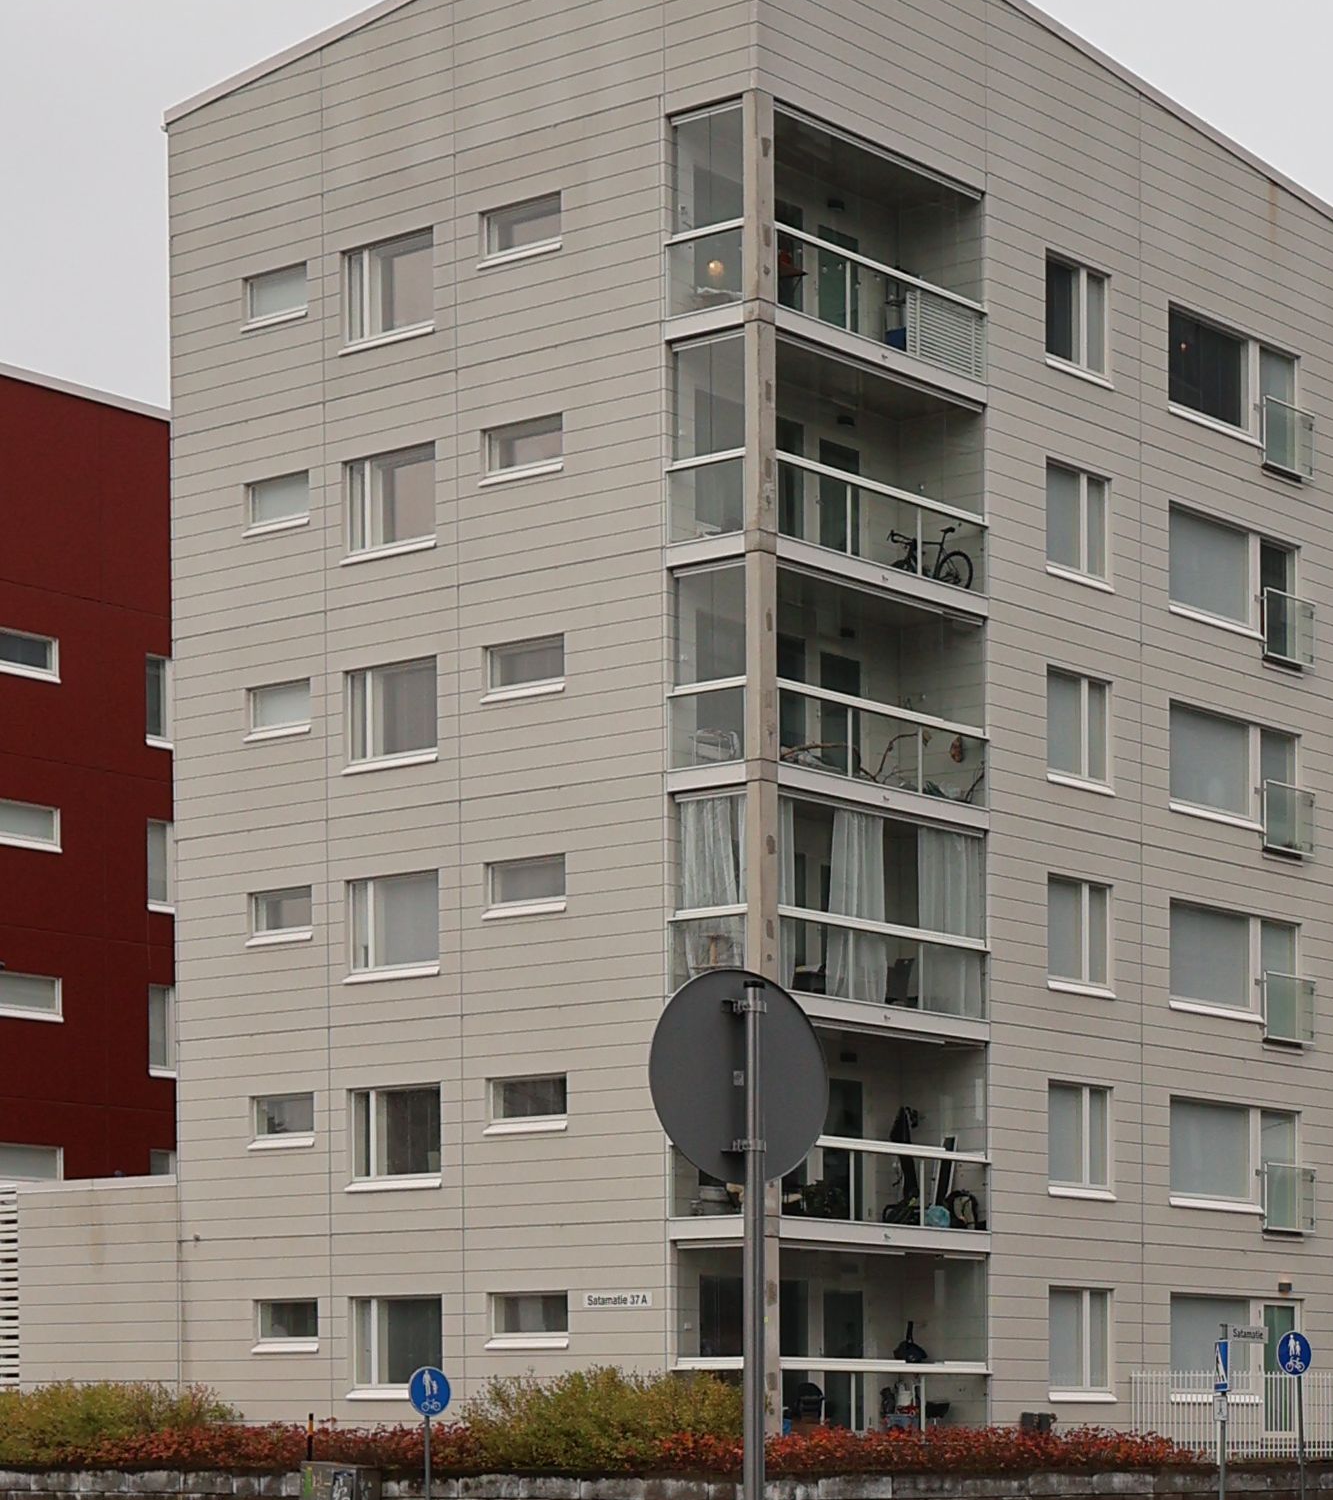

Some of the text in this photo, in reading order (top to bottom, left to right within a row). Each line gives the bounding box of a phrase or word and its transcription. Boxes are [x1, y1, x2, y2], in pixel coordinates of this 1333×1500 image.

[586, 1293, 648, 1306] Satamatie 37 A
[1232, 1327, 1265, 1340] Satamatie
